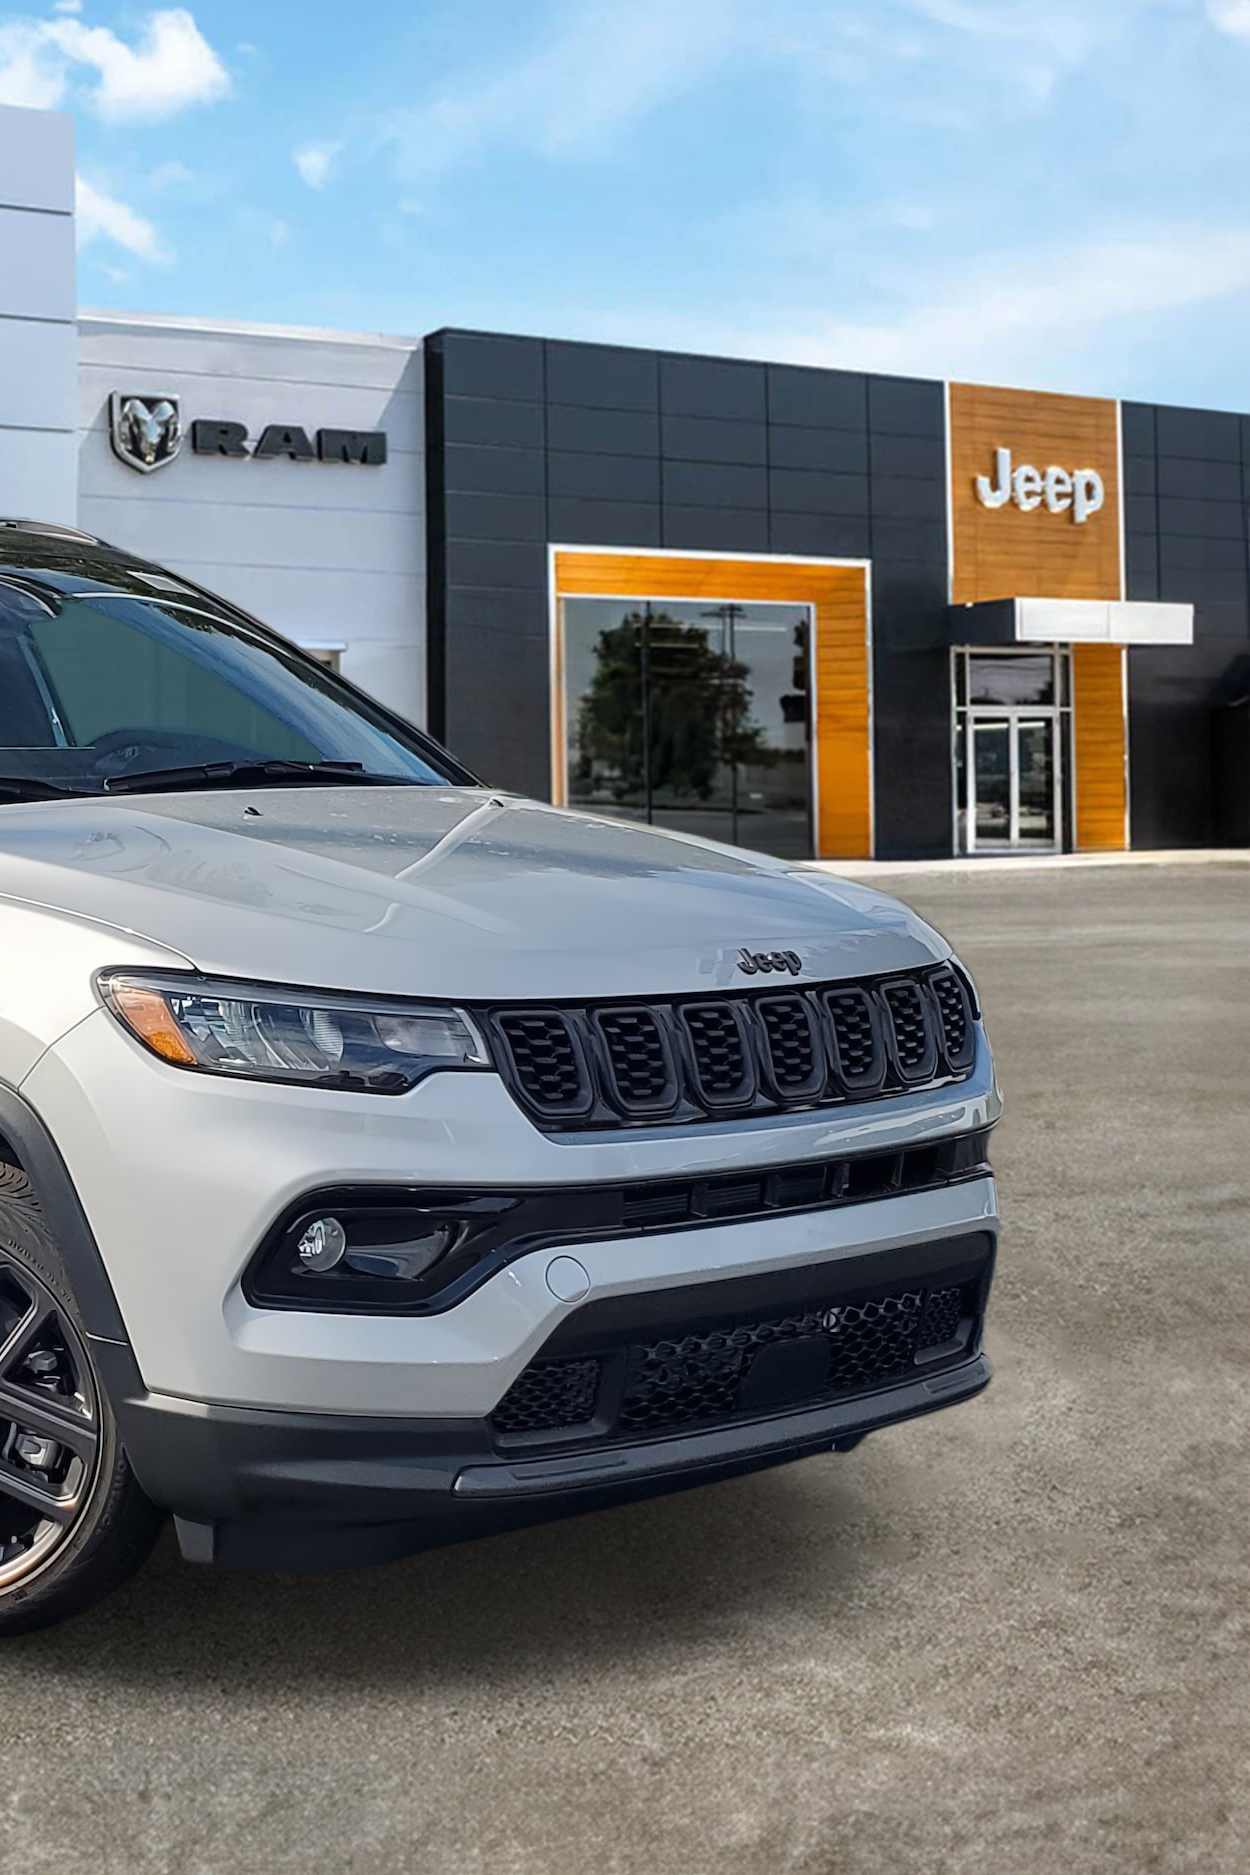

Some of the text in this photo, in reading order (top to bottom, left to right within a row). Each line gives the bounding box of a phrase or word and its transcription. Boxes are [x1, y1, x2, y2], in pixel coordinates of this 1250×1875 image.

[192, 419, 387, 465] RAM
[976, 447, 1104, 523] Jeep
[736, 948, 802, 976] Jeep
